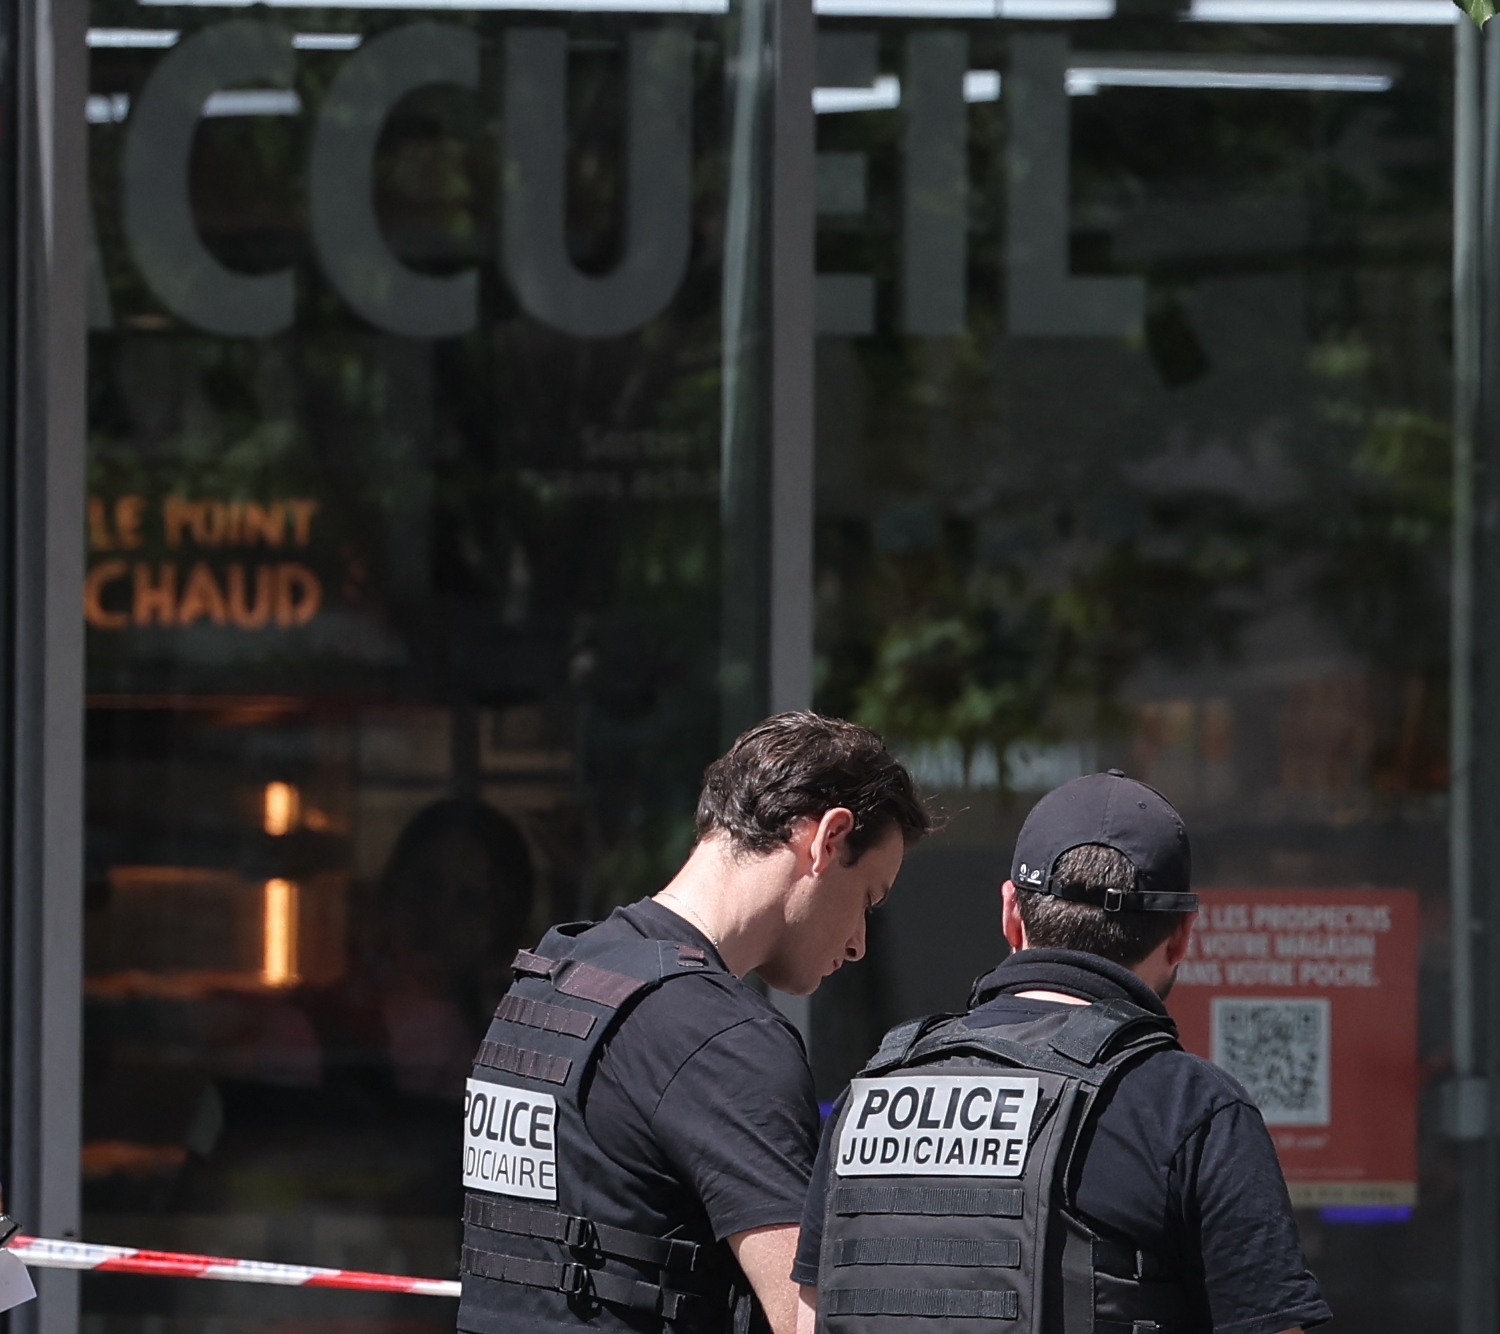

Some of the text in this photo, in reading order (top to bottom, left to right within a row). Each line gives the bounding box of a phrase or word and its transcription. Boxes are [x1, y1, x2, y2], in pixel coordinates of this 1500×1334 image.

[90, 20, 1148, 339] CCUEIL
[88, 495, 320, 551] LE POINT
[85, 559, 322, 633] CHAUD
[855, 1086, 1025, 1131] POLICE
[842, 1136, 1024, 1166] JUDICIAIRE
